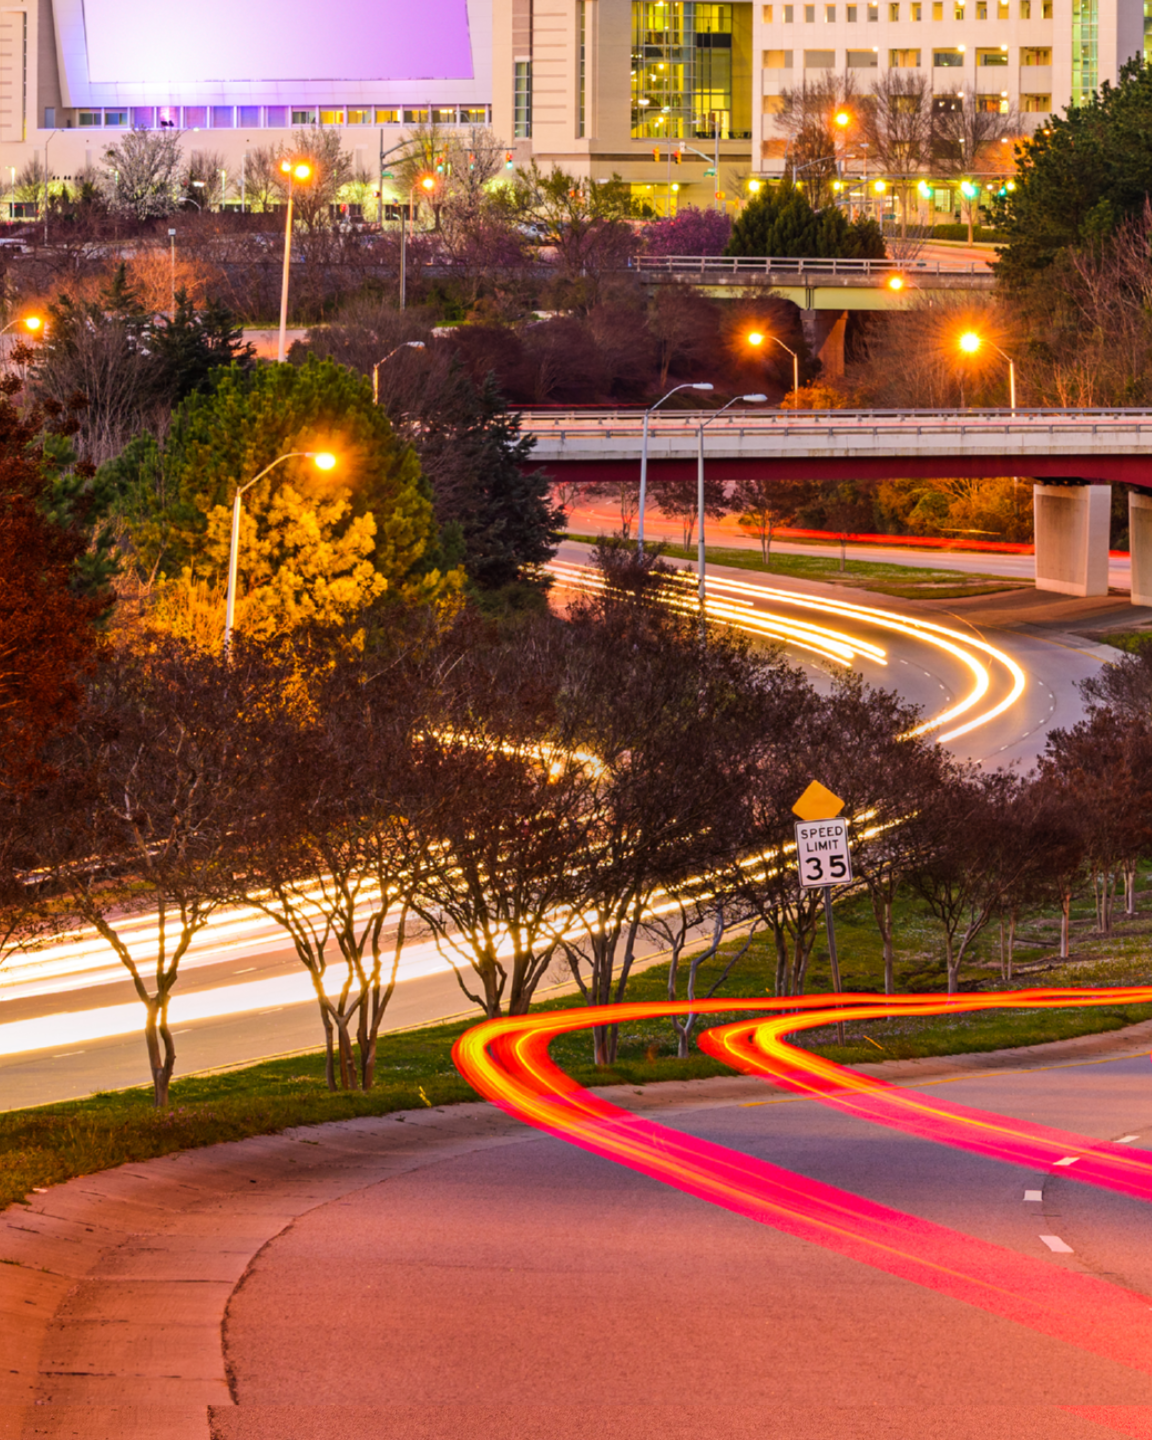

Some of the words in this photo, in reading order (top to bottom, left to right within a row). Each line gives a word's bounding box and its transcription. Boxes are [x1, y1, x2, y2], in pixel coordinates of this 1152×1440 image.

[801, 826, 843, 840] SPEED
[806, 839, 839, 852] LIMIT
[805, 854, 846, 880] 35
